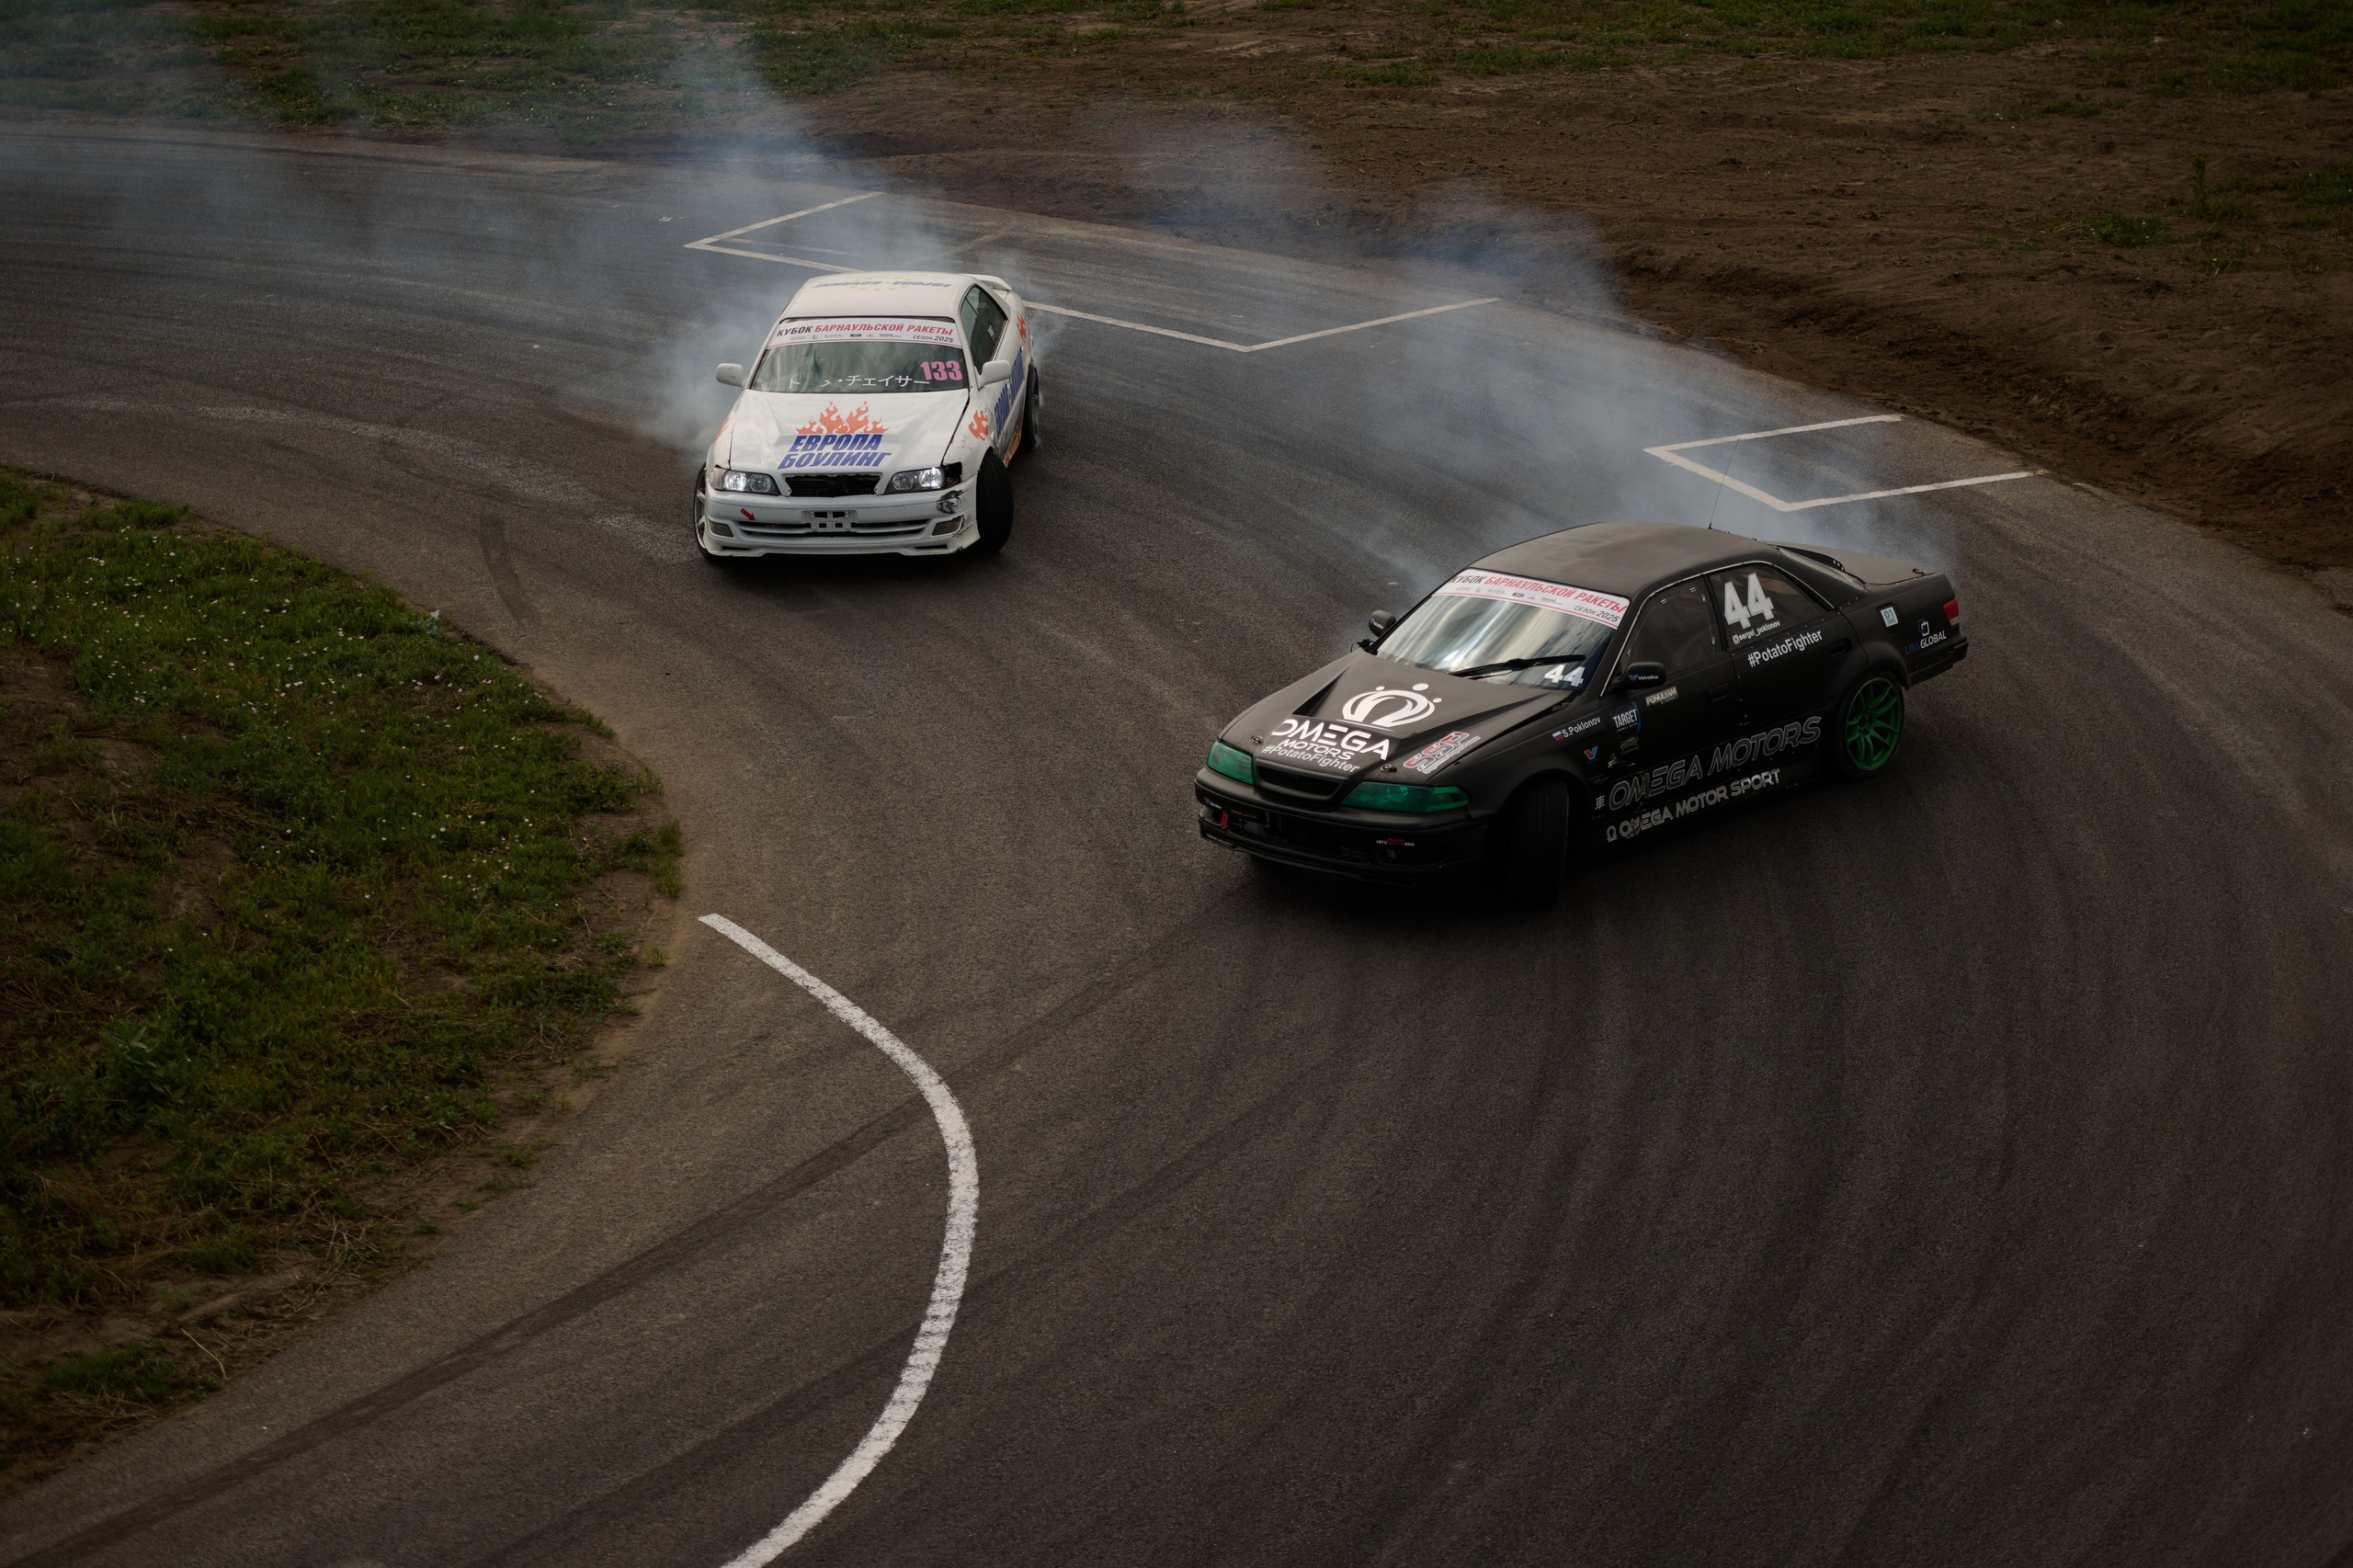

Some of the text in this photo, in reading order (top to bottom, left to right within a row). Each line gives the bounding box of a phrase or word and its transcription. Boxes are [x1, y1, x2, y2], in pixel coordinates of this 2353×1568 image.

[777, 325, 813, 337] КУБОК
[814, 323, 904, 332] БАРНАУЛЬСКОЙ
[906, 324, 954, 335] РАКЕТЫ
[920, 360, 962, 381] 133
[788, 434, 882, 452] ЕВРОПА
[778, 451, 892, 470] БОУЛИНГ
[1483, 576, 1577, 598] БАРНАУЛЬСКОЙ
[1574, 592, 1628, 613] РАКЕТЫ
[1724, 572, 1775, 630] 44
[1574, 606, 1621, 622] СЕЗОН 2025
[1747, 630, 1823, 668] #PotatoFighter
[1544, 664, 1586, 687] 44
[1561, 717, 1601, 738] S.Poklonov
[1613, 709, 1638, 729] TARGET
[1271, 719, 1390, 761] OMEGA
[1278, 739, 1355, 760] MOTORS
[1403, 731, 1470, 772] SSP
[1261, 744, 1360, 773] #PotatoFighter
[1608, 716, 1823, 811] OMEGA MOTORS
[1619, 767, 1780, 838] OMEGA MOTOR SPORT
